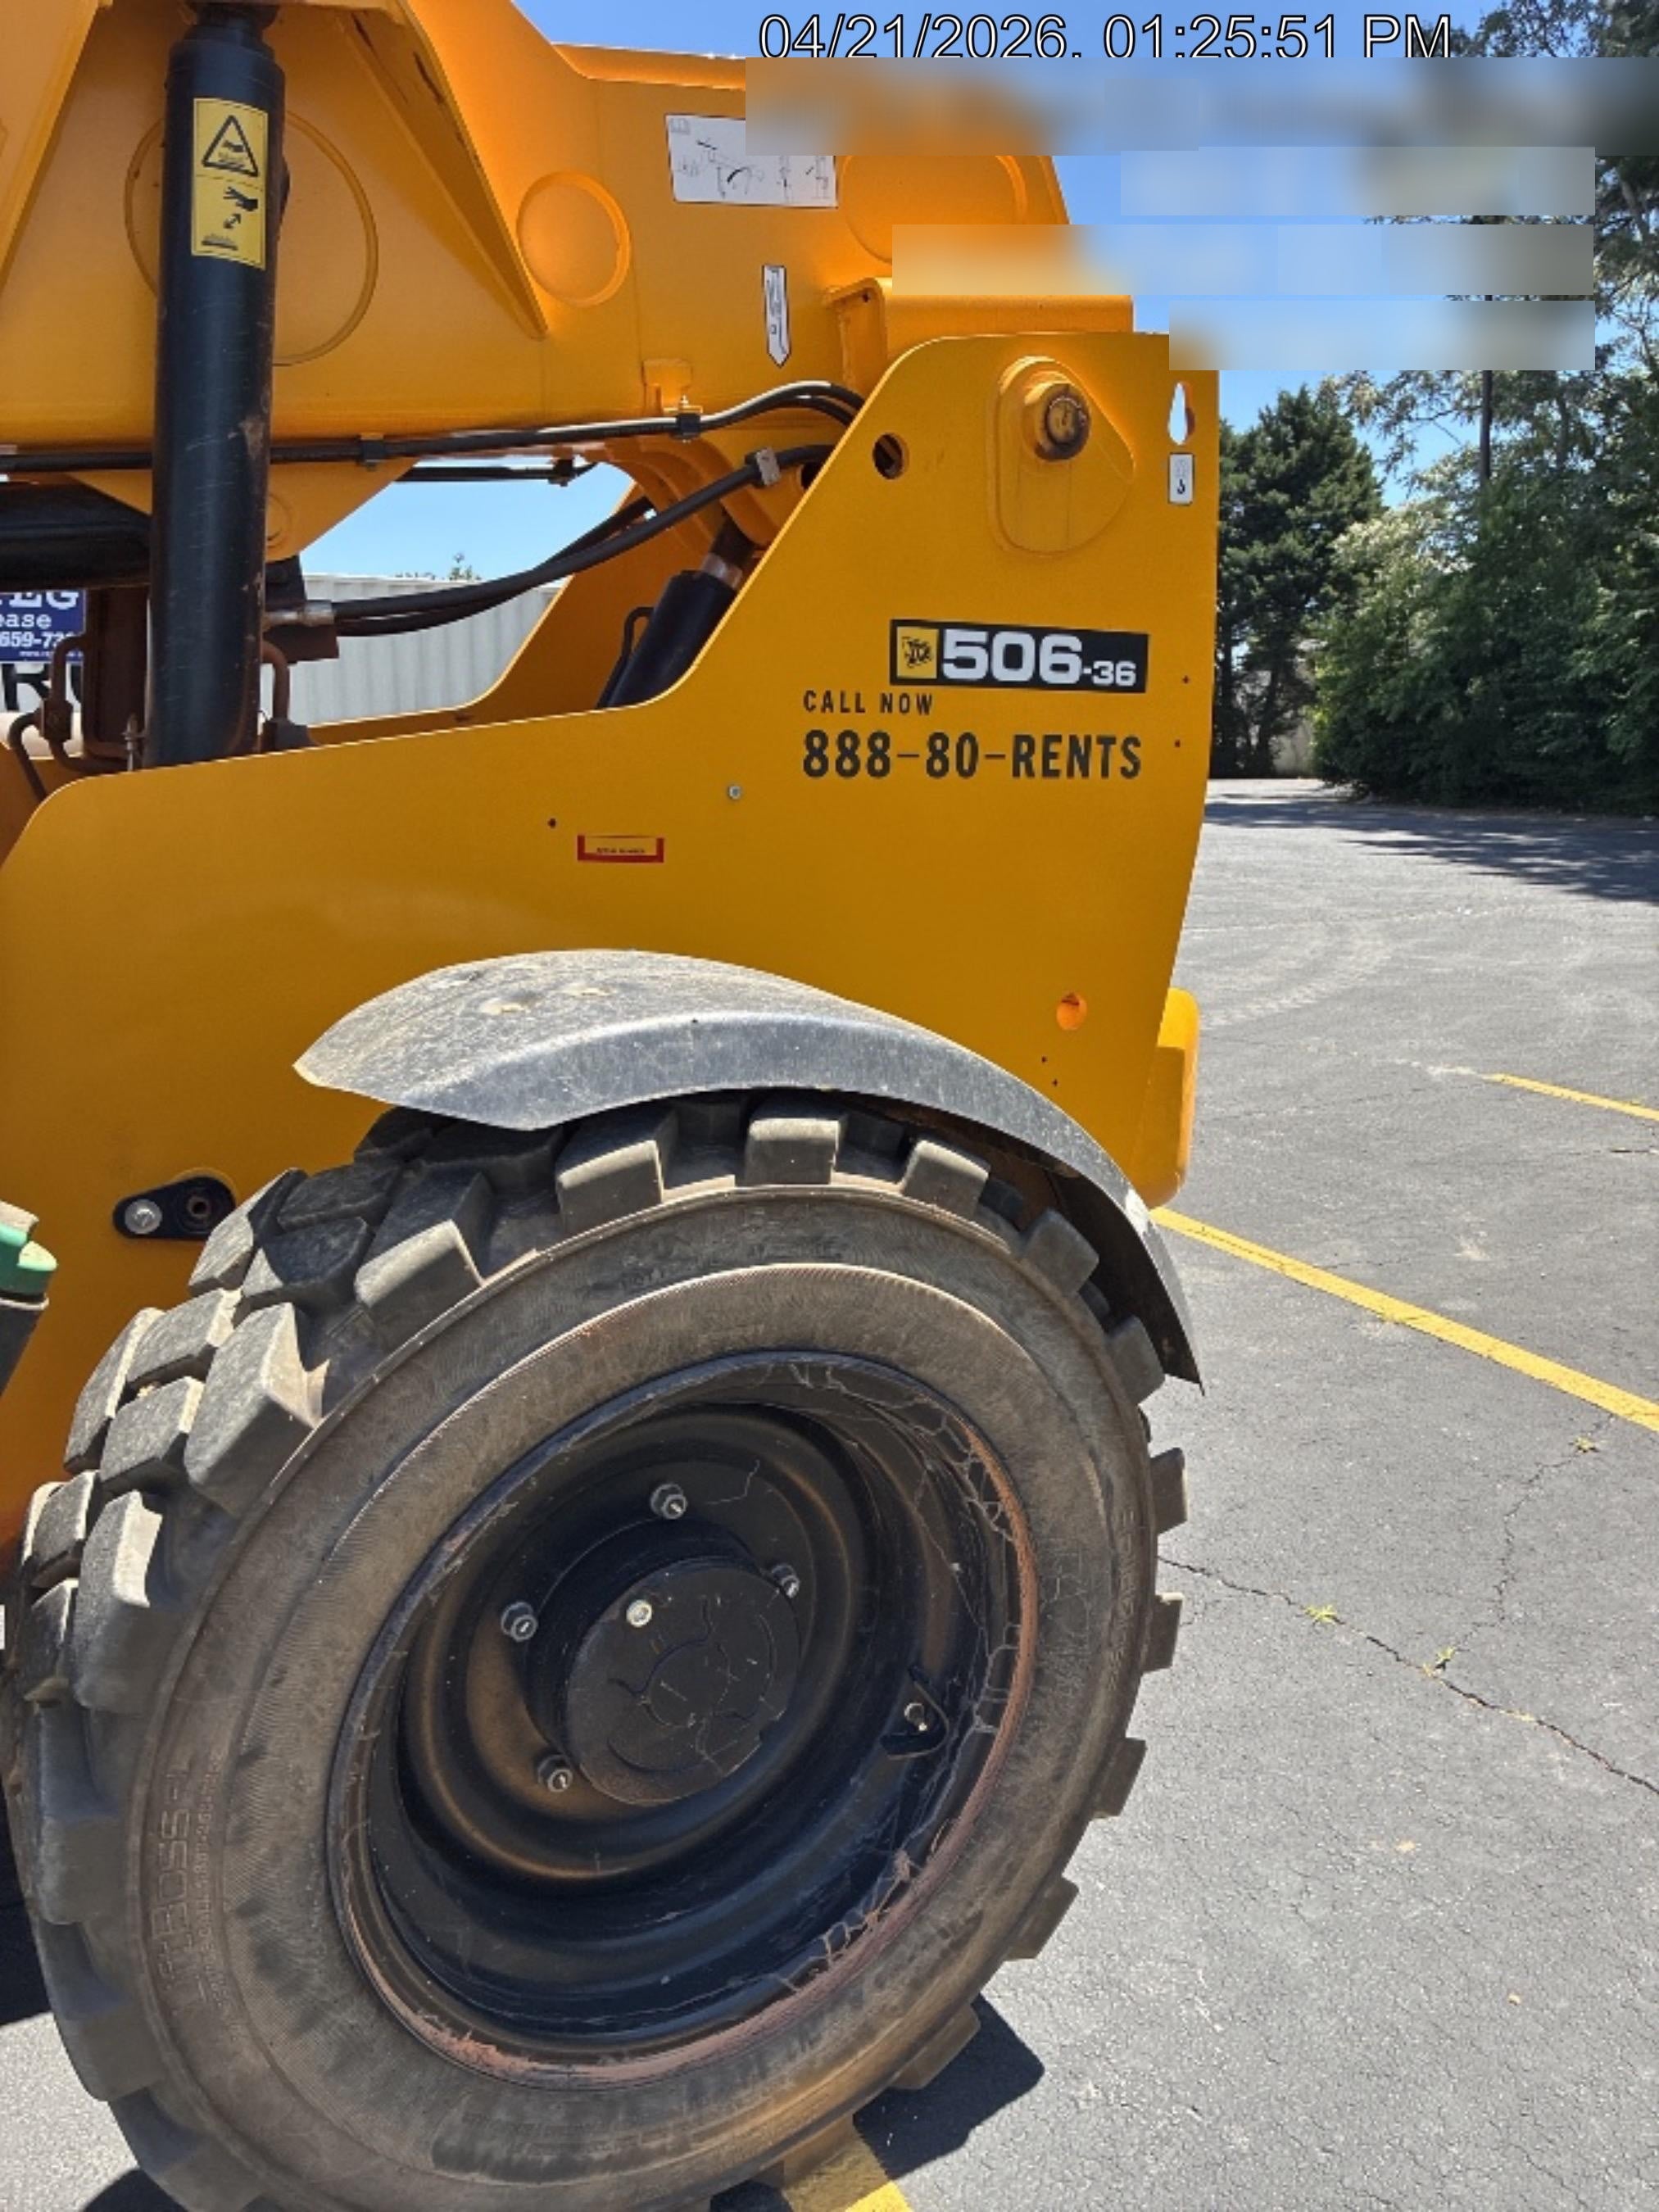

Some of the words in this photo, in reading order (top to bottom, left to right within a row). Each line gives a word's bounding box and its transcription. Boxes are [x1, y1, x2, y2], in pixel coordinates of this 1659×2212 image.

[803, 690, 865, 714] CALL
[880, 692, 932, 715] NOW
[803, 729, 1141, 778] 888-80-RENTS
